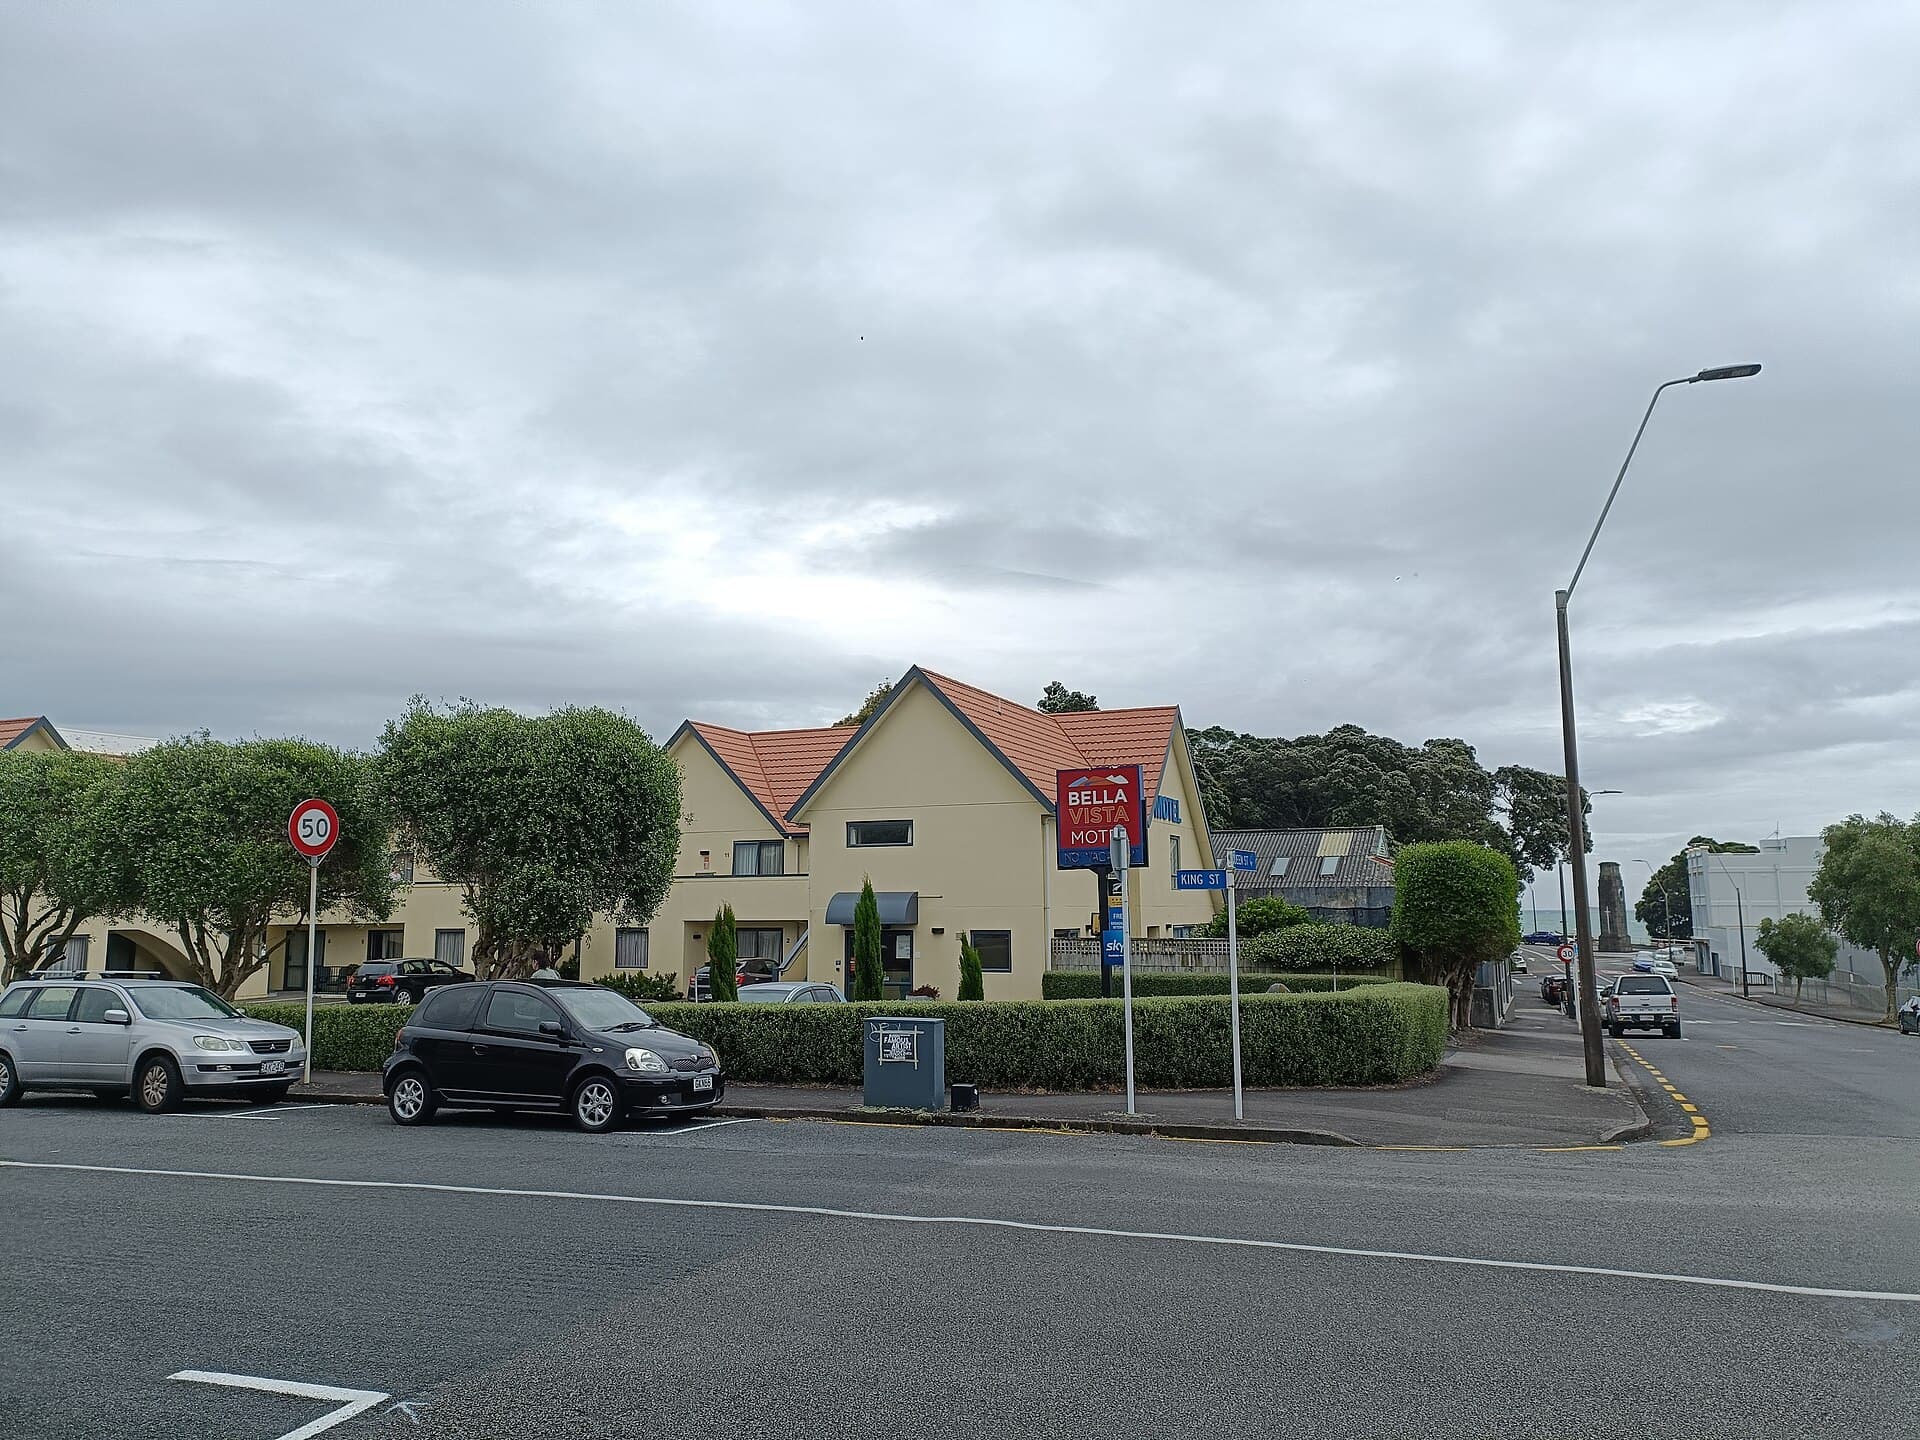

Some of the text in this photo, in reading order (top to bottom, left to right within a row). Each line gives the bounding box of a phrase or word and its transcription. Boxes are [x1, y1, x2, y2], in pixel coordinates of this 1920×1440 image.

[1068, 789, 1128, 806] BELLA
[1068, 806, 1129, 825] VISTA
[1154, 795, 1181, 824] MOTEL
[302, 818, 328, 838] 50
[1071, 829, 1113, 845] MOT
[1181, 873, 1220, 885] KING ST
